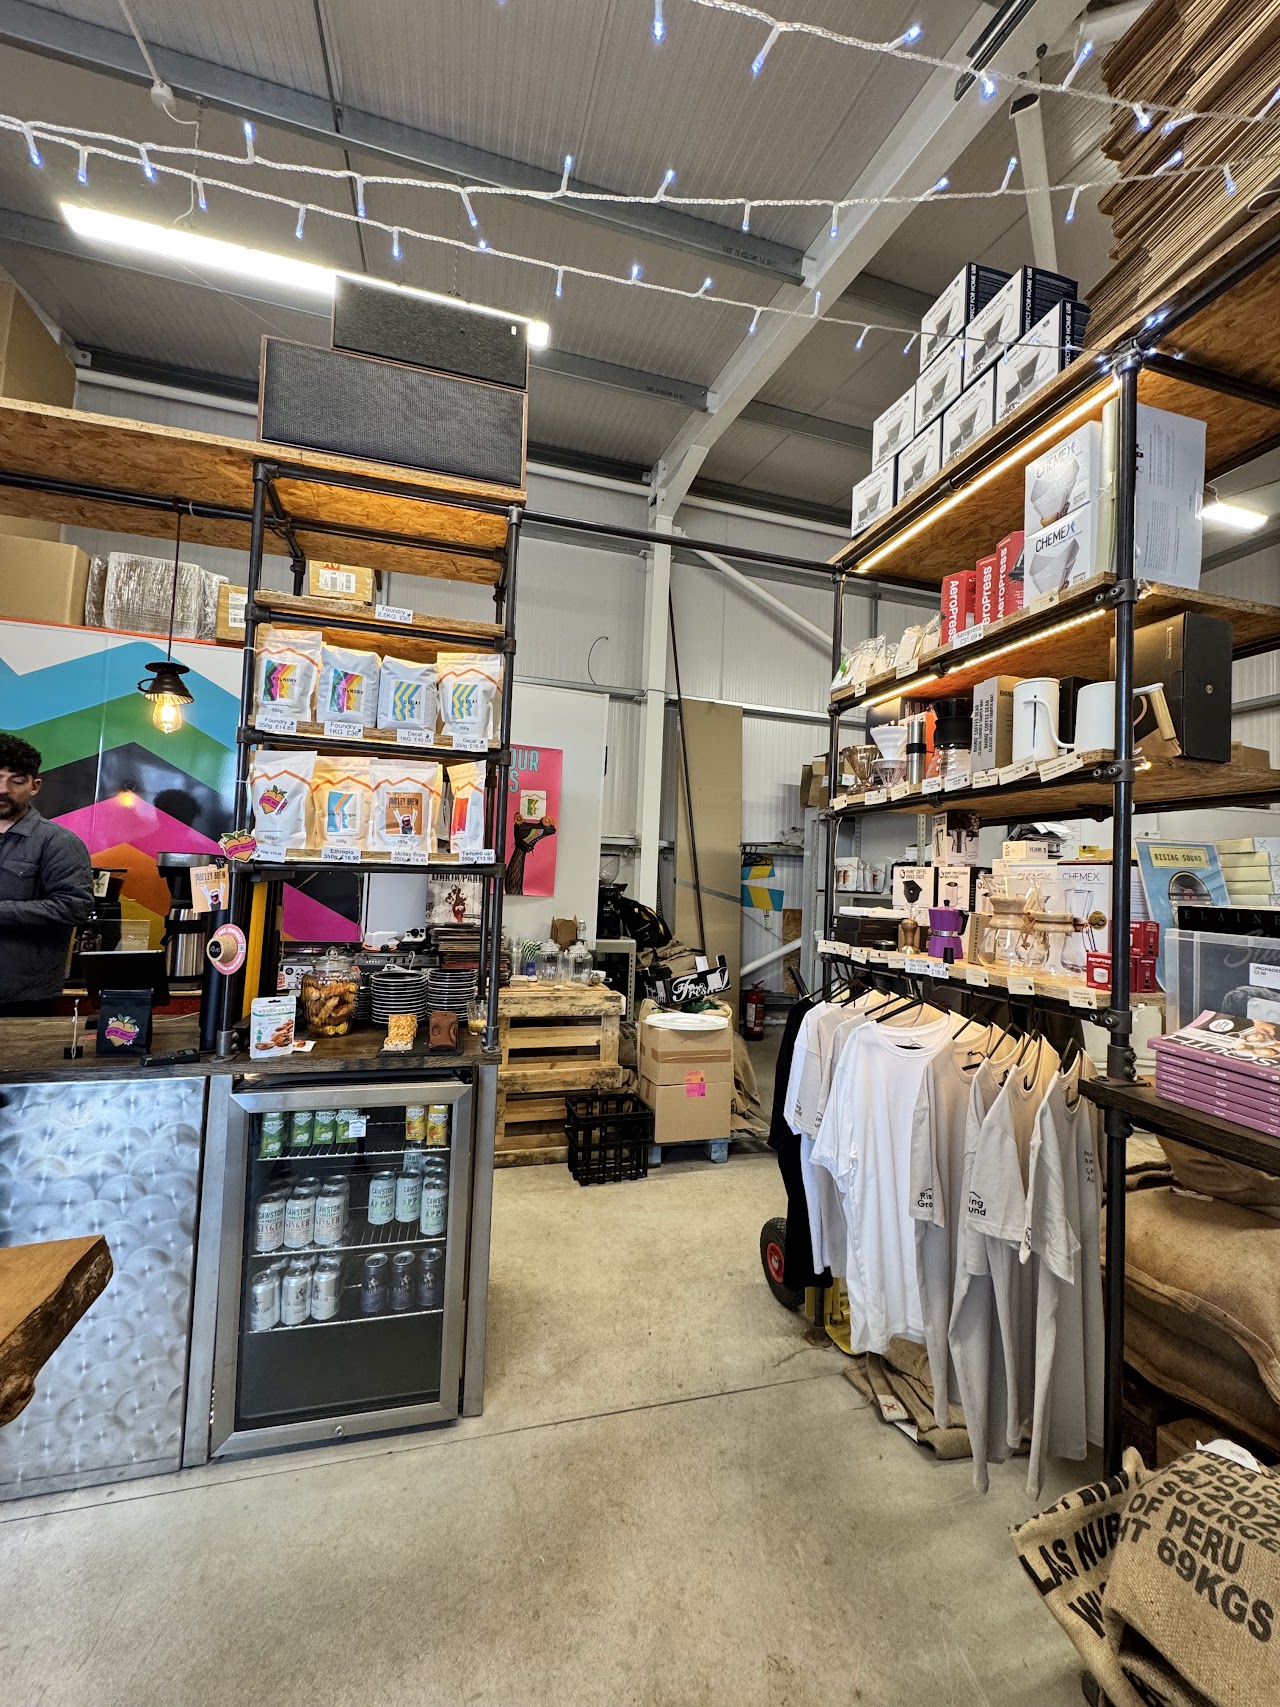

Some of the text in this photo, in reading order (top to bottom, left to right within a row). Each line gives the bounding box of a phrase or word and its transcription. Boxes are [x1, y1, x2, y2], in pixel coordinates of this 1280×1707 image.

[1035, 520, 1076, 553] CHEMEX
[997, 547, 1007, 618] AeroPress
[982, 566, 992, 625] eroPress
[382, 607, 405, 615] Foundry
[377, 612, 396, 620] 2.5KG
[956, 626, 981, 639] Aeropress
[961, 634, 977, 645] £31.99
[342, 687, 363, 695] OUNDRY
[264, 717, 287, 725] Foundry
[331, 722, 356, 730] Foundry
[509, 748, 540, 773] OUR
[407, 797, 419, 806] BREW
[1182, 854, 1202, 862] SOUND
[214, 871, 225, 879] BREW
[1062, 872, 1100, 882] CHEMEX
[1088, 957, 1112, 965] AeroPres
[932, 969, 947, 977] £18.99
[372, 1187, 394, 1195] CAWSTON
[917, 1200, 934, 1208] Gro
[968, 1197, 984, 1209] ing
[287, 1208, 311, 1216] CAWSTON
[317, 1204, 340, 1213] CAWSTON
[968, 1206, 987, 1216] und
[258, 1209, 283, 1219] CAWSTON
[286, 1220, 310, 1228] GINGER
[315, 1217, 339, 1226] GINGER
[257, 1221, 283, 1232] GINGER
[1129, 1493, 1245, 1575] OF PERU
[1019, 1513, 1122, 1596] LAS NUB
[1157, 1536, 1274, 1643] 69KGS
